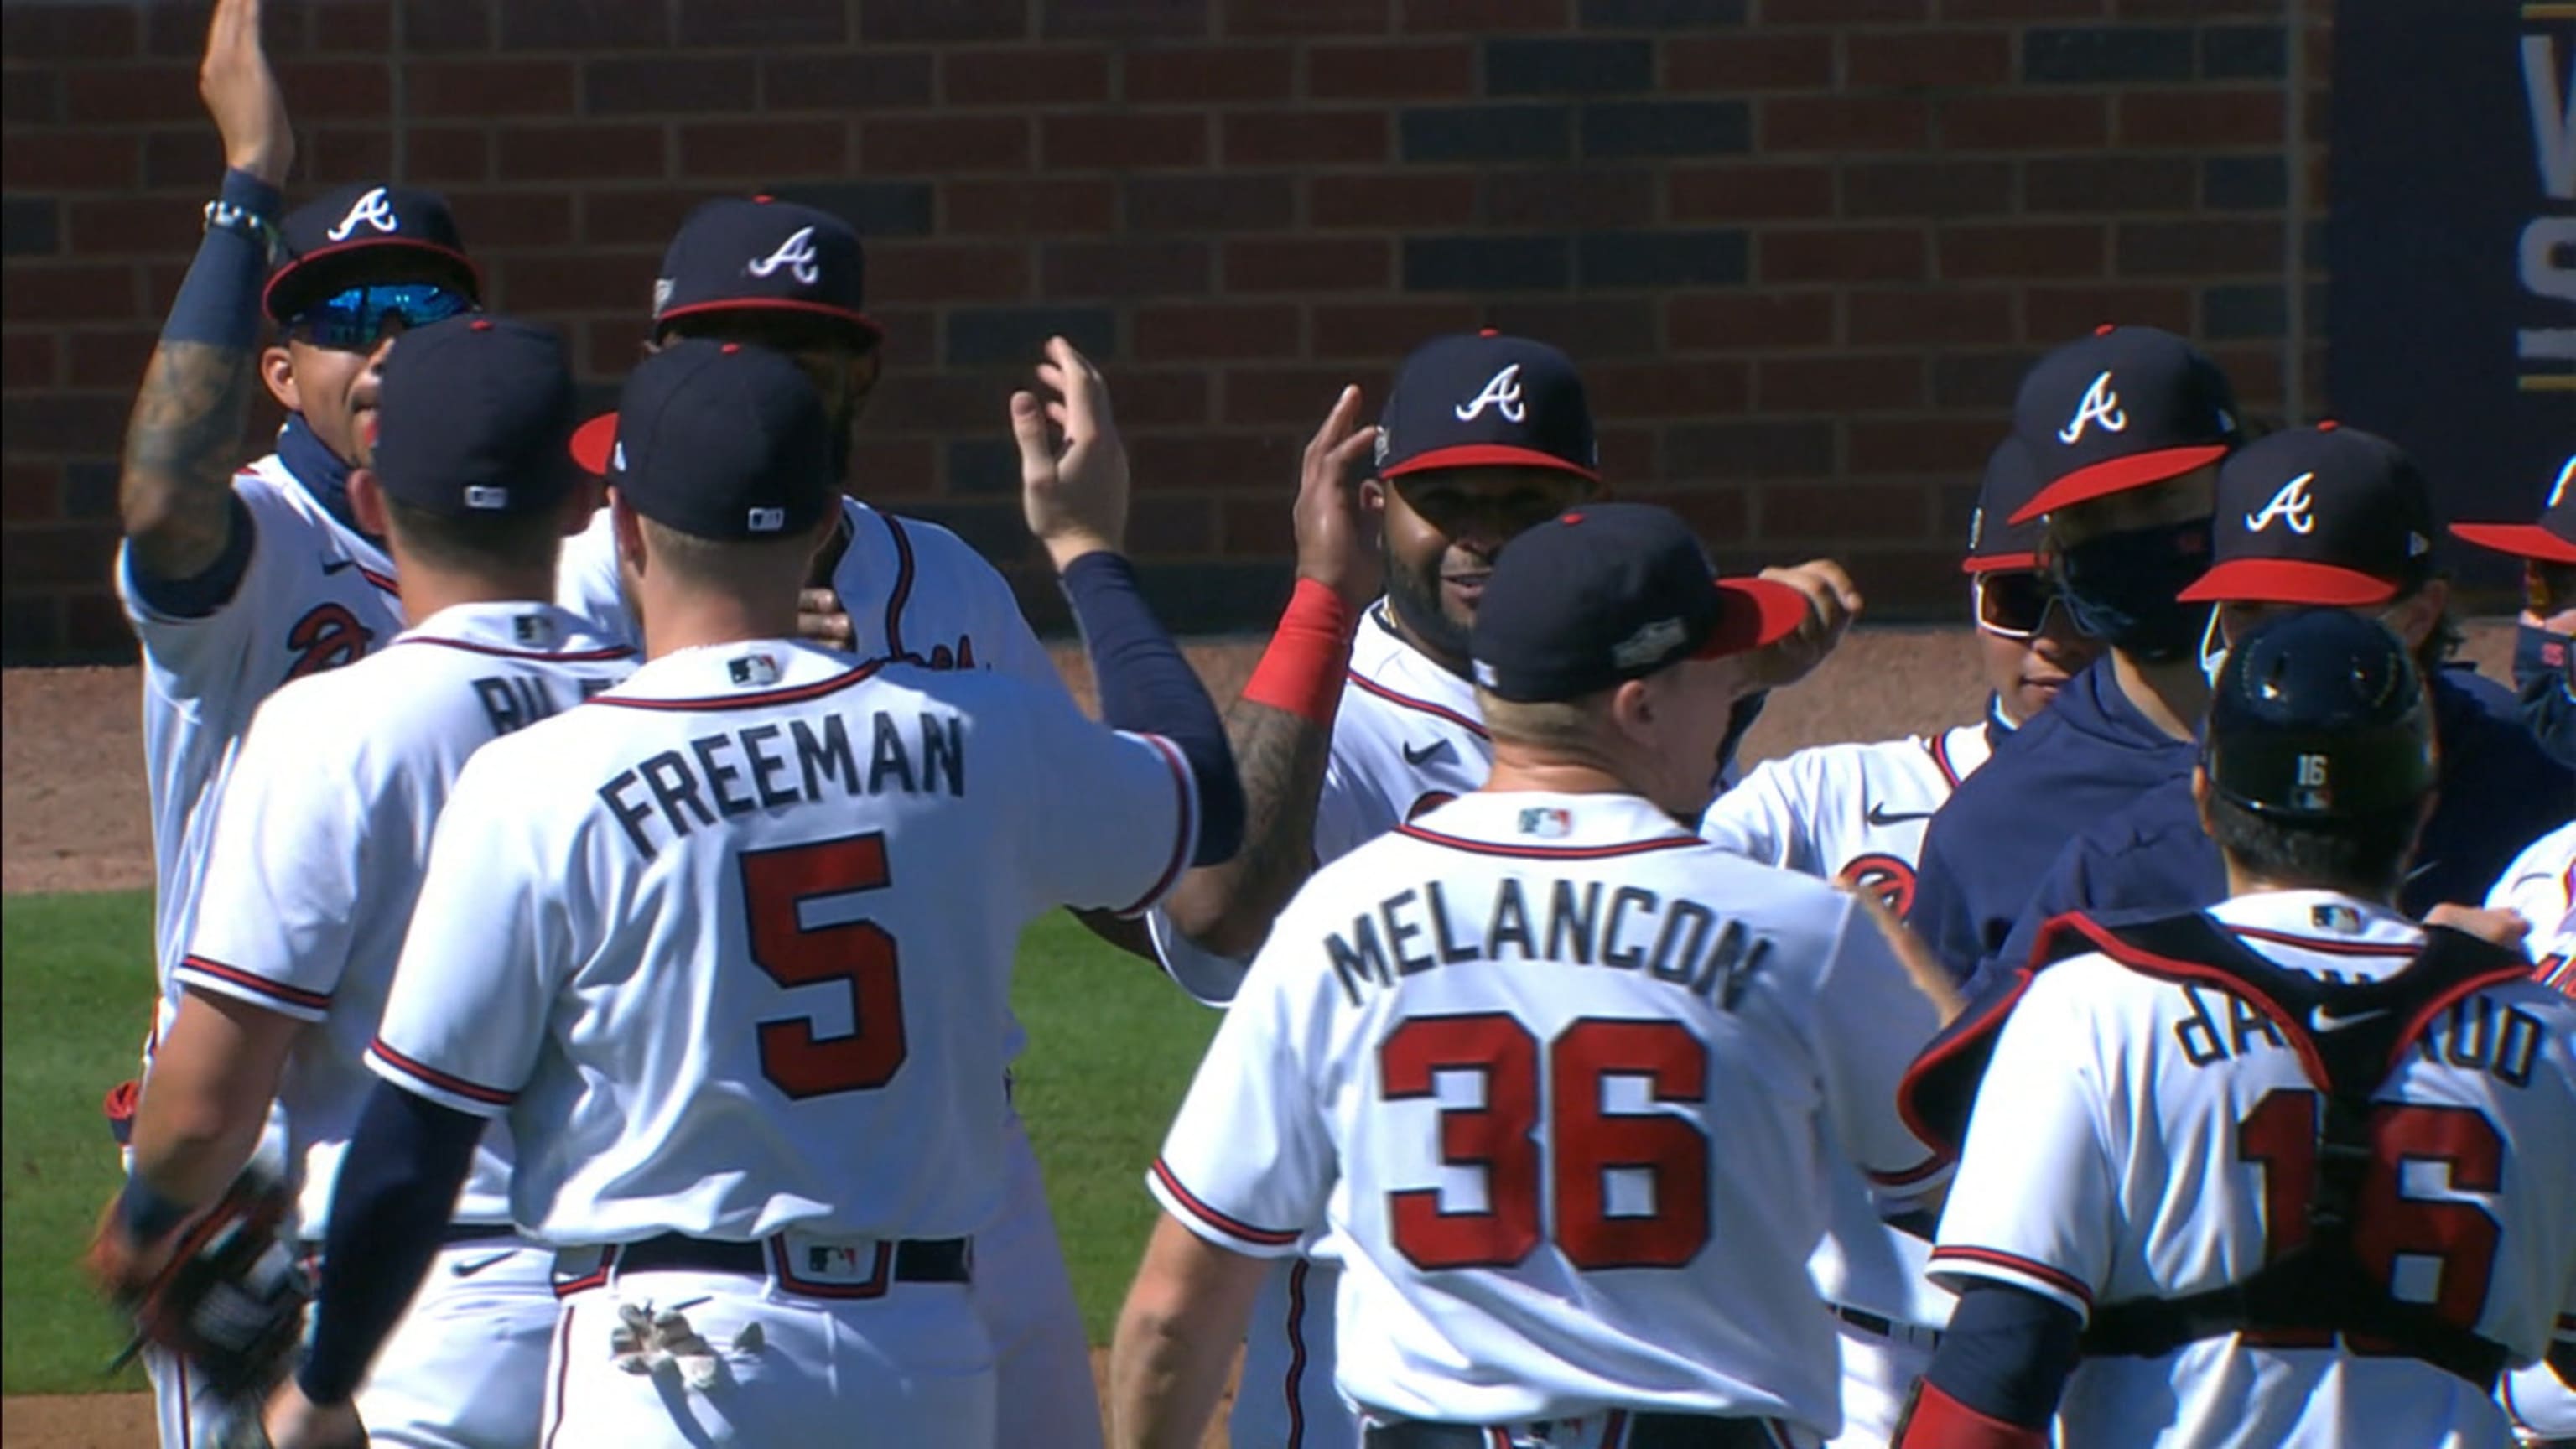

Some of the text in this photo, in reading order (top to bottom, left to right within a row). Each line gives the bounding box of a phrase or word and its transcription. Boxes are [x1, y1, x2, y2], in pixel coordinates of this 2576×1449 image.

[326, 187, 397, 242] A
[747, 226, 818, 283] A
[1455, 363, 1525, 423] A
[2058, 371, 2126, 444] A
[2246, 471, 2313, 534] A
[598, 710, 966, 860] FREEMAN
[2298, 754, 2329, 786] 16
[738, 829, 908, 1102] 5
[1322, 877, 1773, 1011] MELANCON
[1376, 1011, 1711, 1272] 36
[2236, 1088, 2505, 1348] 16
